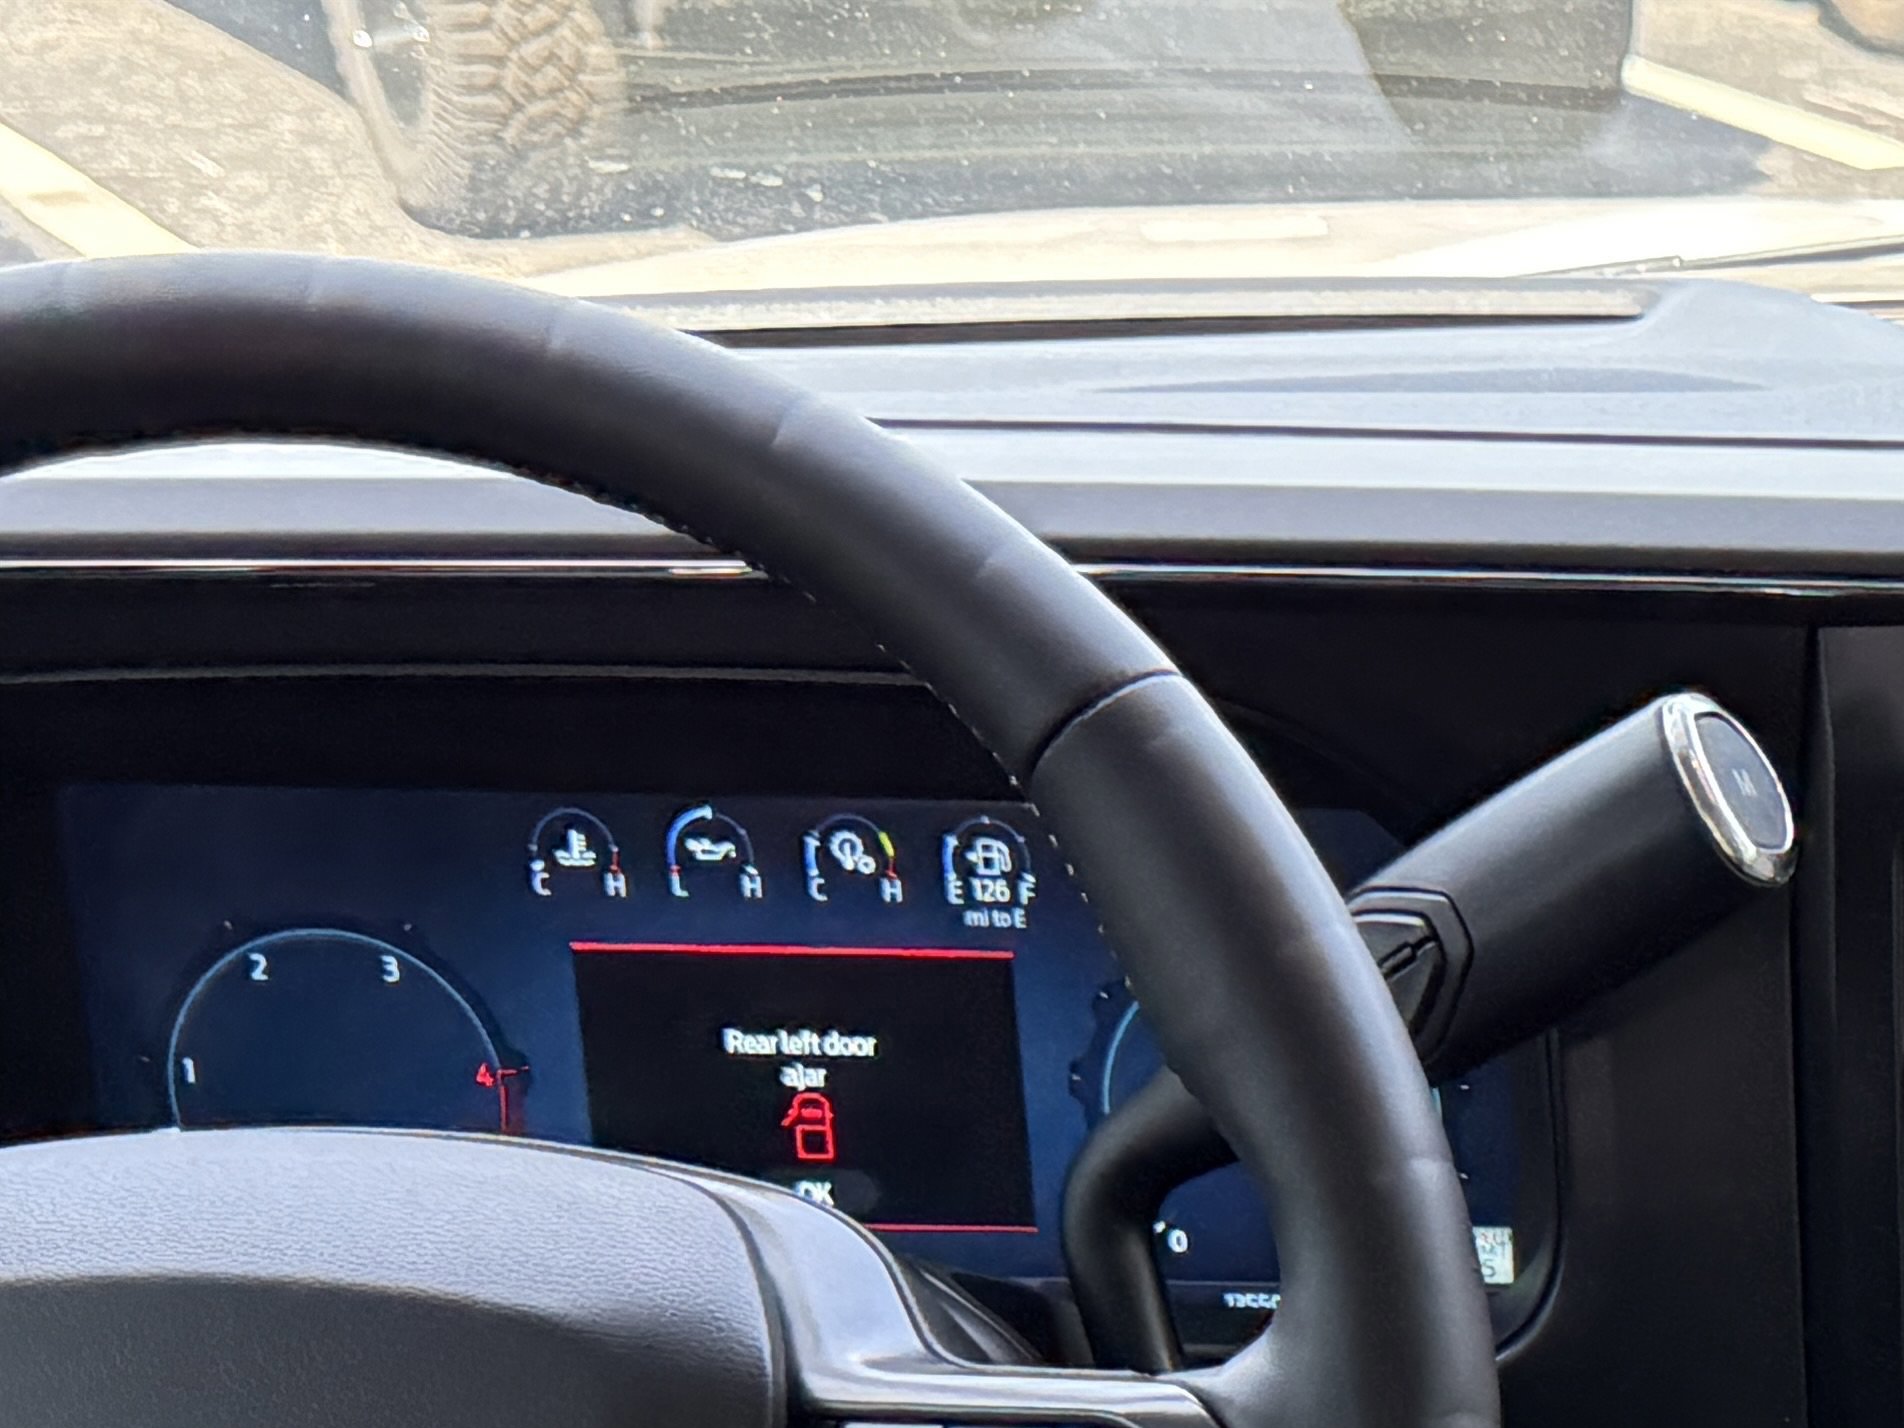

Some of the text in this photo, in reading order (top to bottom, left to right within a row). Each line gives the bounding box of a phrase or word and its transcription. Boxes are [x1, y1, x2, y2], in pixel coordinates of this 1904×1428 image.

[530, 870, 552, 897] C
[604, 871, 628, 898] H
[671, 875, 690, 898] L
[740, 872, 763, 898] H
[807, 875, 829, 901] C
[882, 876, 904, 903] H
[948, 879, 966, 905] E
[970, 877, 1012, 903] 126
[1018, 878, 1036, 905] F
[963, 909, 1028, 928] mi to E
[248, 952, 269, 982] 2
[381, 955, 400, 983] 3
[722, 1027, 878, 1057] Rear left door
[183, 1056, 196, 1084] 1
[476, 1062, 495, 1088] 4
[779, 1063, 827, 1090] ajar
[1167, 1229, 1189, 1254] 0
